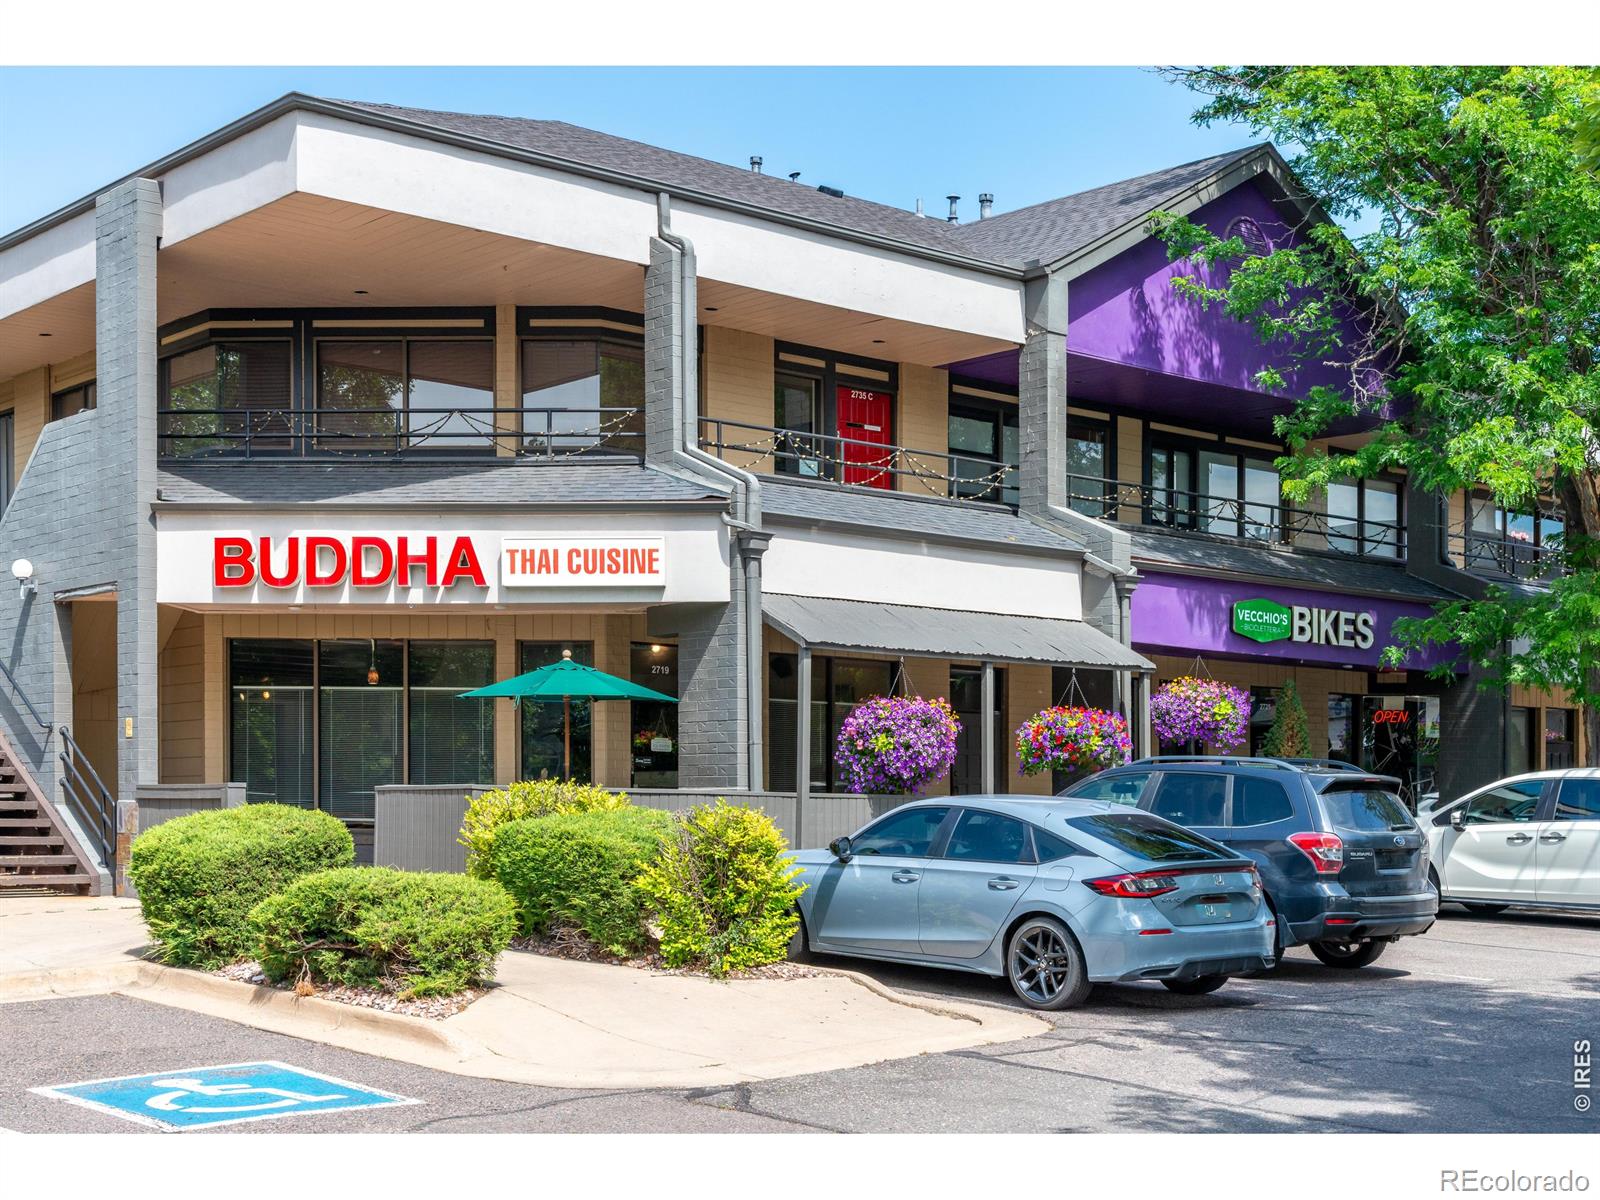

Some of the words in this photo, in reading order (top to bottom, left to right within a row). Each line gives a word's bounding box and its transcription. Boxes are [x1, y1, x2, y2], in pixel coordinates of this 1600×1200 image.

[851, 390, 867, 400] 2735
[868, 392, 874, 400] C
[213, 536, 487, 588] BUDDHA
[506, 548, 559, 574] THAI
[567, 548, 659, 574] CUISINE
[1237, 609, 1288, 625] VECCHIO'S
[1292, 605, 1375, 649] BIKES
[651, 665, 669, 674] 2719
[1374, 710, 1409, 723] OPEN
